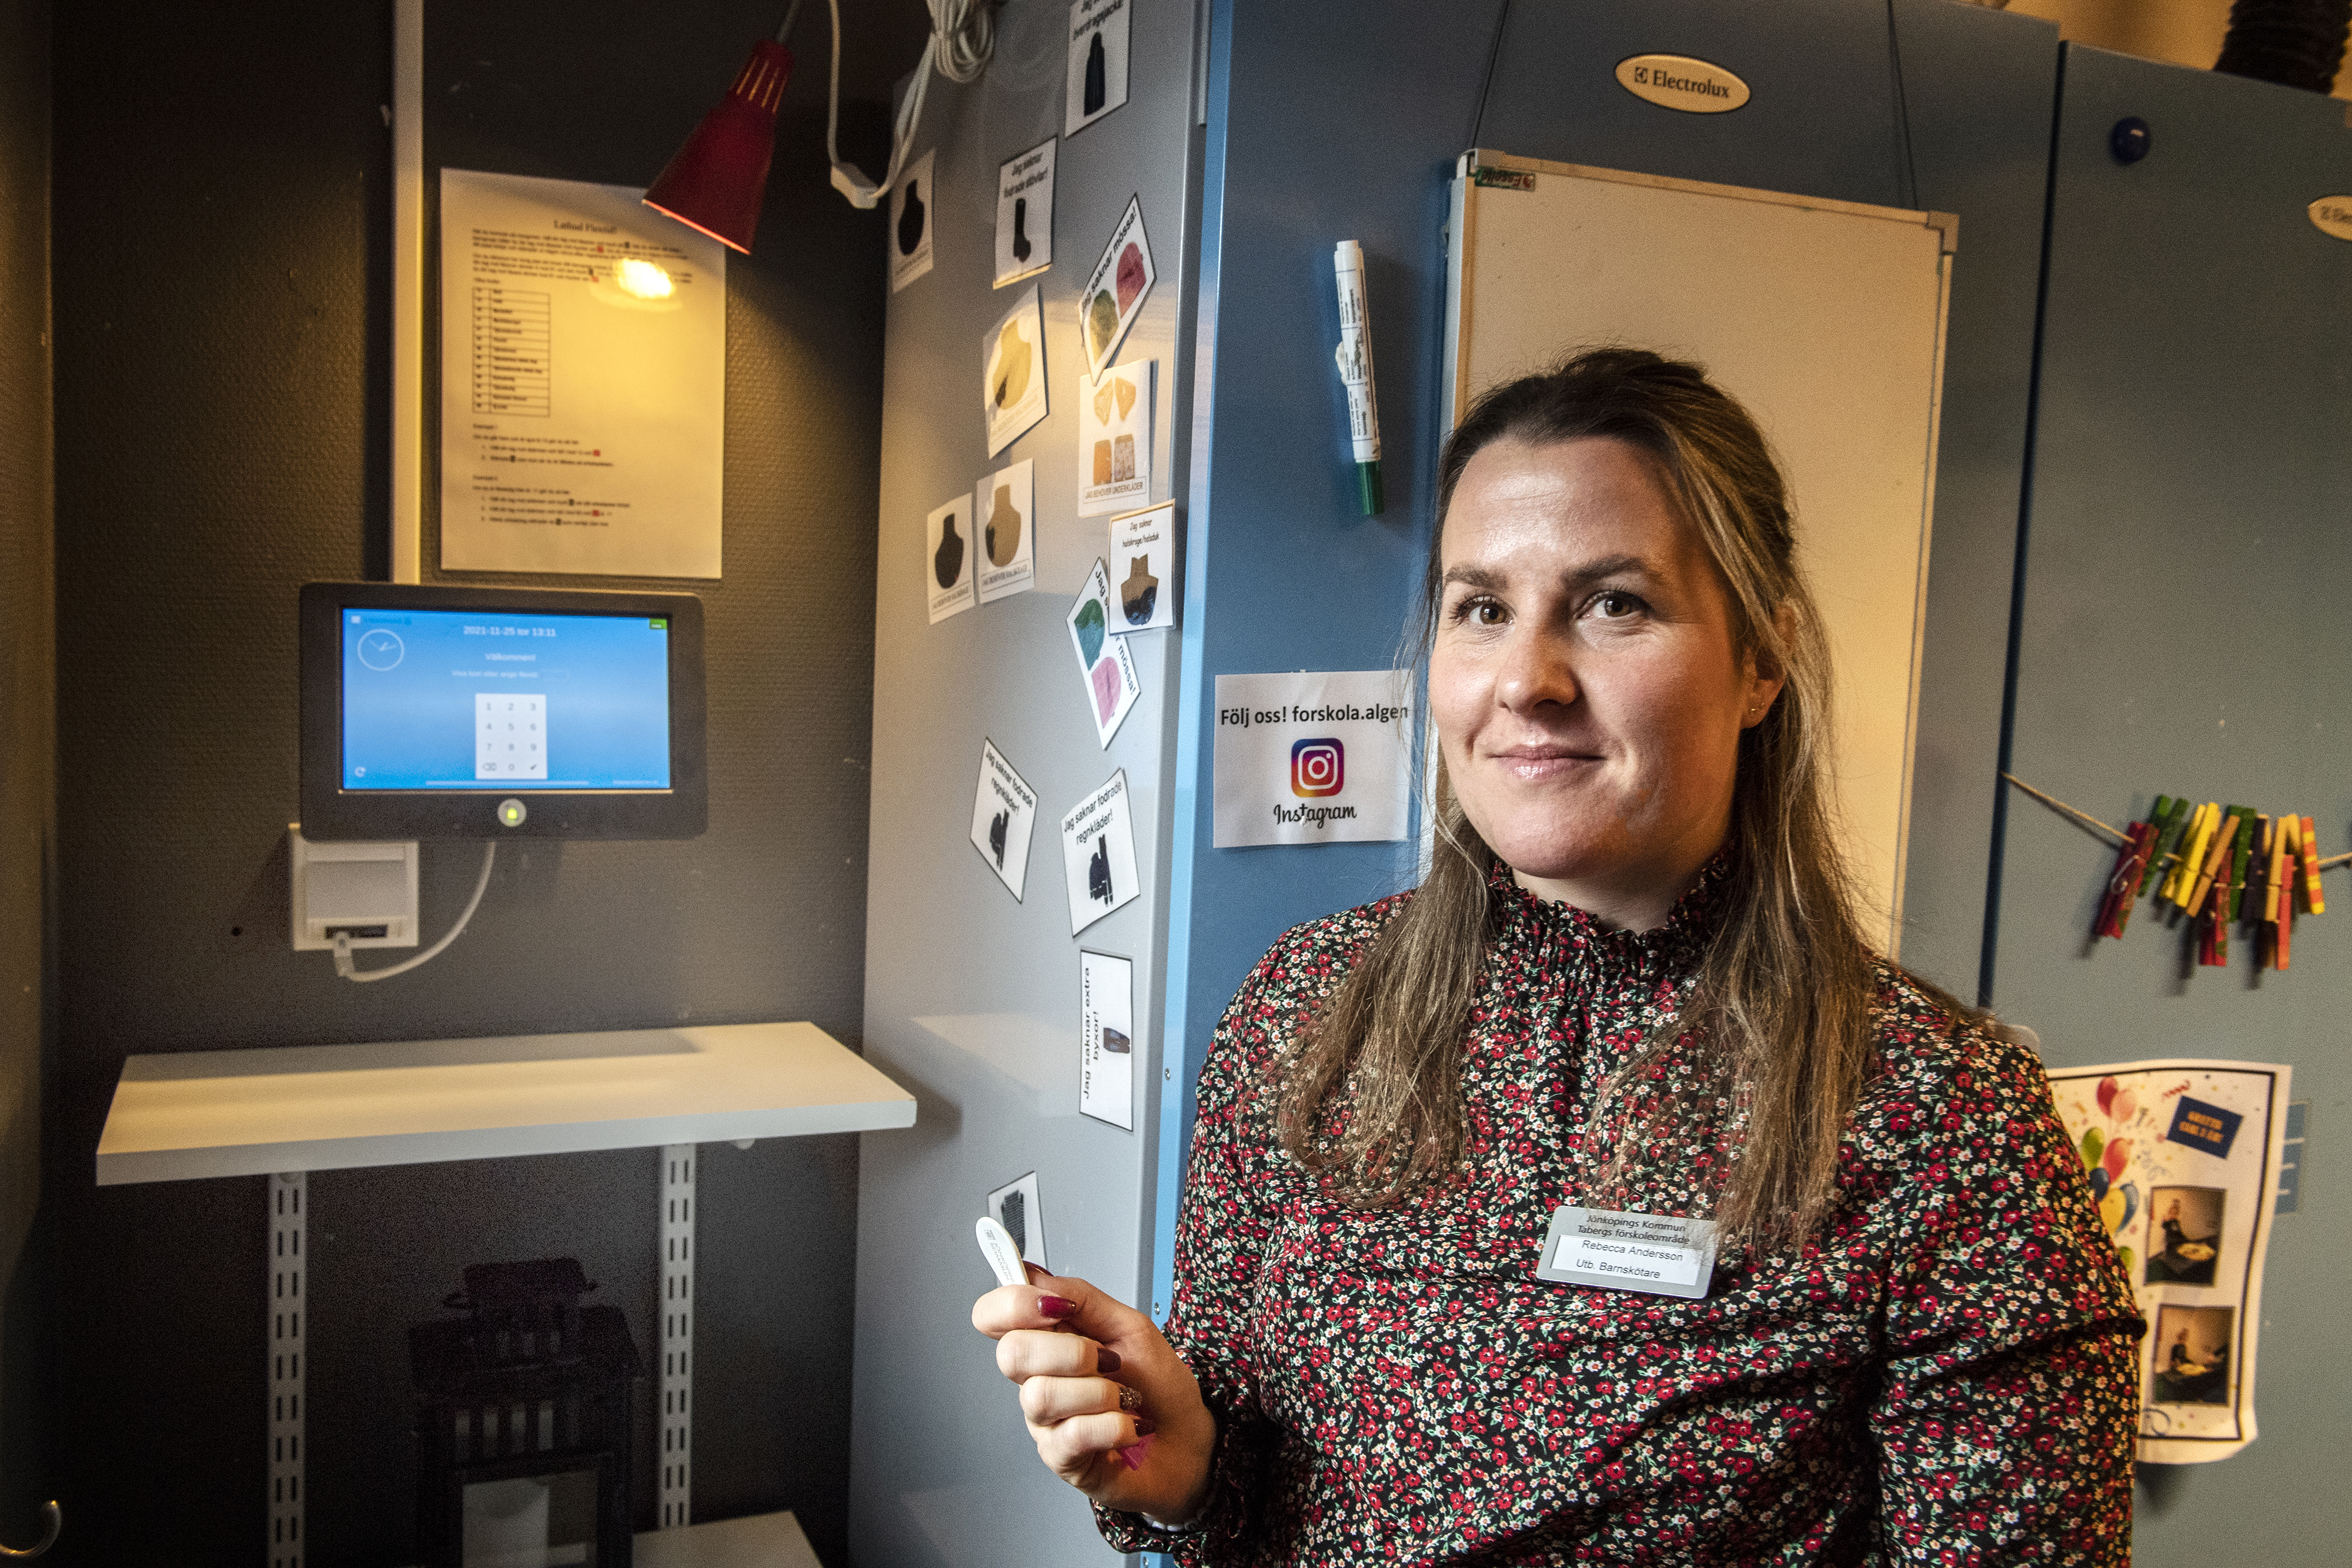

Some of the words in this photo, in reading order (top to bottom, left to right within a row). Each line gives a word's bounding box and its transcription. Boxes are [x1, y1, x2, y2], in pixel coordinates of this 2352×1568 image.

[1653, 70, 1730, 98] Electrolux
[1091, 251, 1113, 293] saknar
[1112, 206, 1137, 254] mössa!
[1095, 571, 1106, 597] Jag
[1118, 644, 1136, 695] mössa!
[1221, 708, 1250, 728] Följ
[1254, 707, 1287, 724] oss!
[1292, 704, 1408, 724] forskola.algen
[1064, 818, 1075, 833] Jag
[1075, 801, 1097, 824] saknar
[1097, 781, 1122, 807] fodrade
[1274, 803, 1357, 830] Instagram
[1076, 808, 1113, 845] regnkläder!
[1083, 1071, 1091, 1099] Jag
[1578, 1225, 1612, 1238] Tabergs
[1615, 1228, 1690, 1245] förskoleområde
[1586, 1215, 1639, 1229] Jönköpings
[1642, 1221, 1686, 1232] Kommun
[990, 1242, 1010, 1280] KOMMUN
[1582, 1240, 1626, 1253] Rebecca
[1628, 1246, 1683, 1261] Andersson
[1576, 1259, 1595, 1269] Utb.
[1599, 1262, 1661, 1279] Barnskötare
